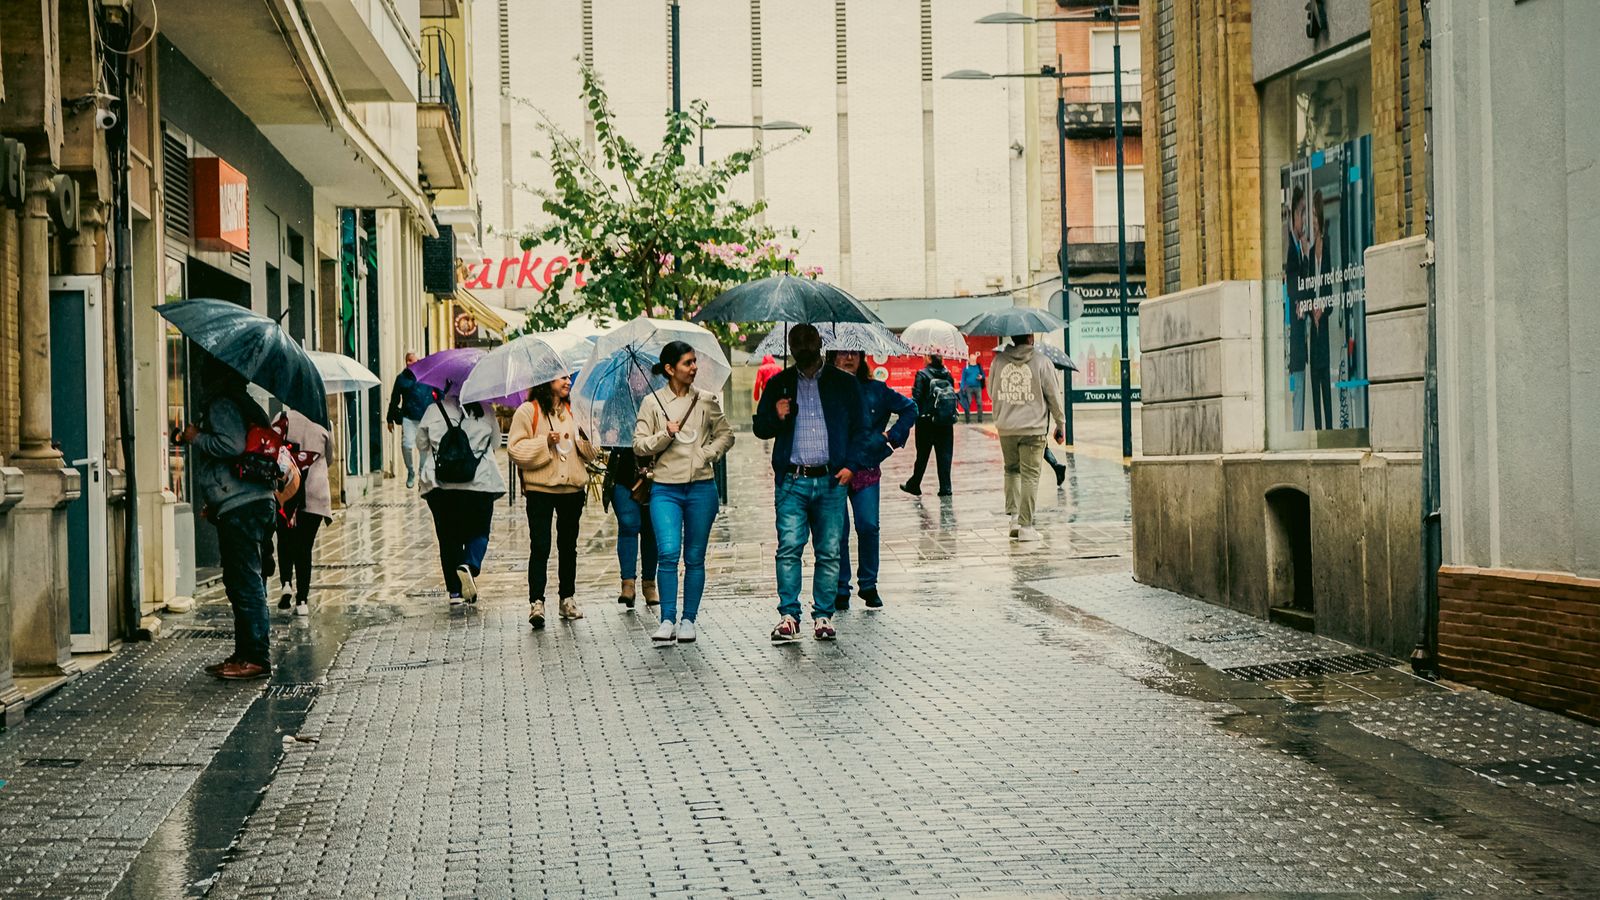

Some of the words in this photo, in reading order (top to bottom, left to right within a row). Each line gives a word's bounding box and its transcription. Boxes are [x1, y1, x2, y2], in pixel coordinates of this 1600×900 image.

[1297, 276, 1304, 291] La
[1305, 273, 1324, 292] mayor
[1324, 266, 1335, 285] red
[1335, 264, 1343, 283] de
[1343, 262, 1365, 281] oficina
[1106, 286, 1131, 298] PAA
[1083, 306, 1109, 314] MAGINA
[1299, 298, 1313, 317] para
[1313, 293, 1340, 312] empresas
[1346, 288, 1367, 308] pymes
